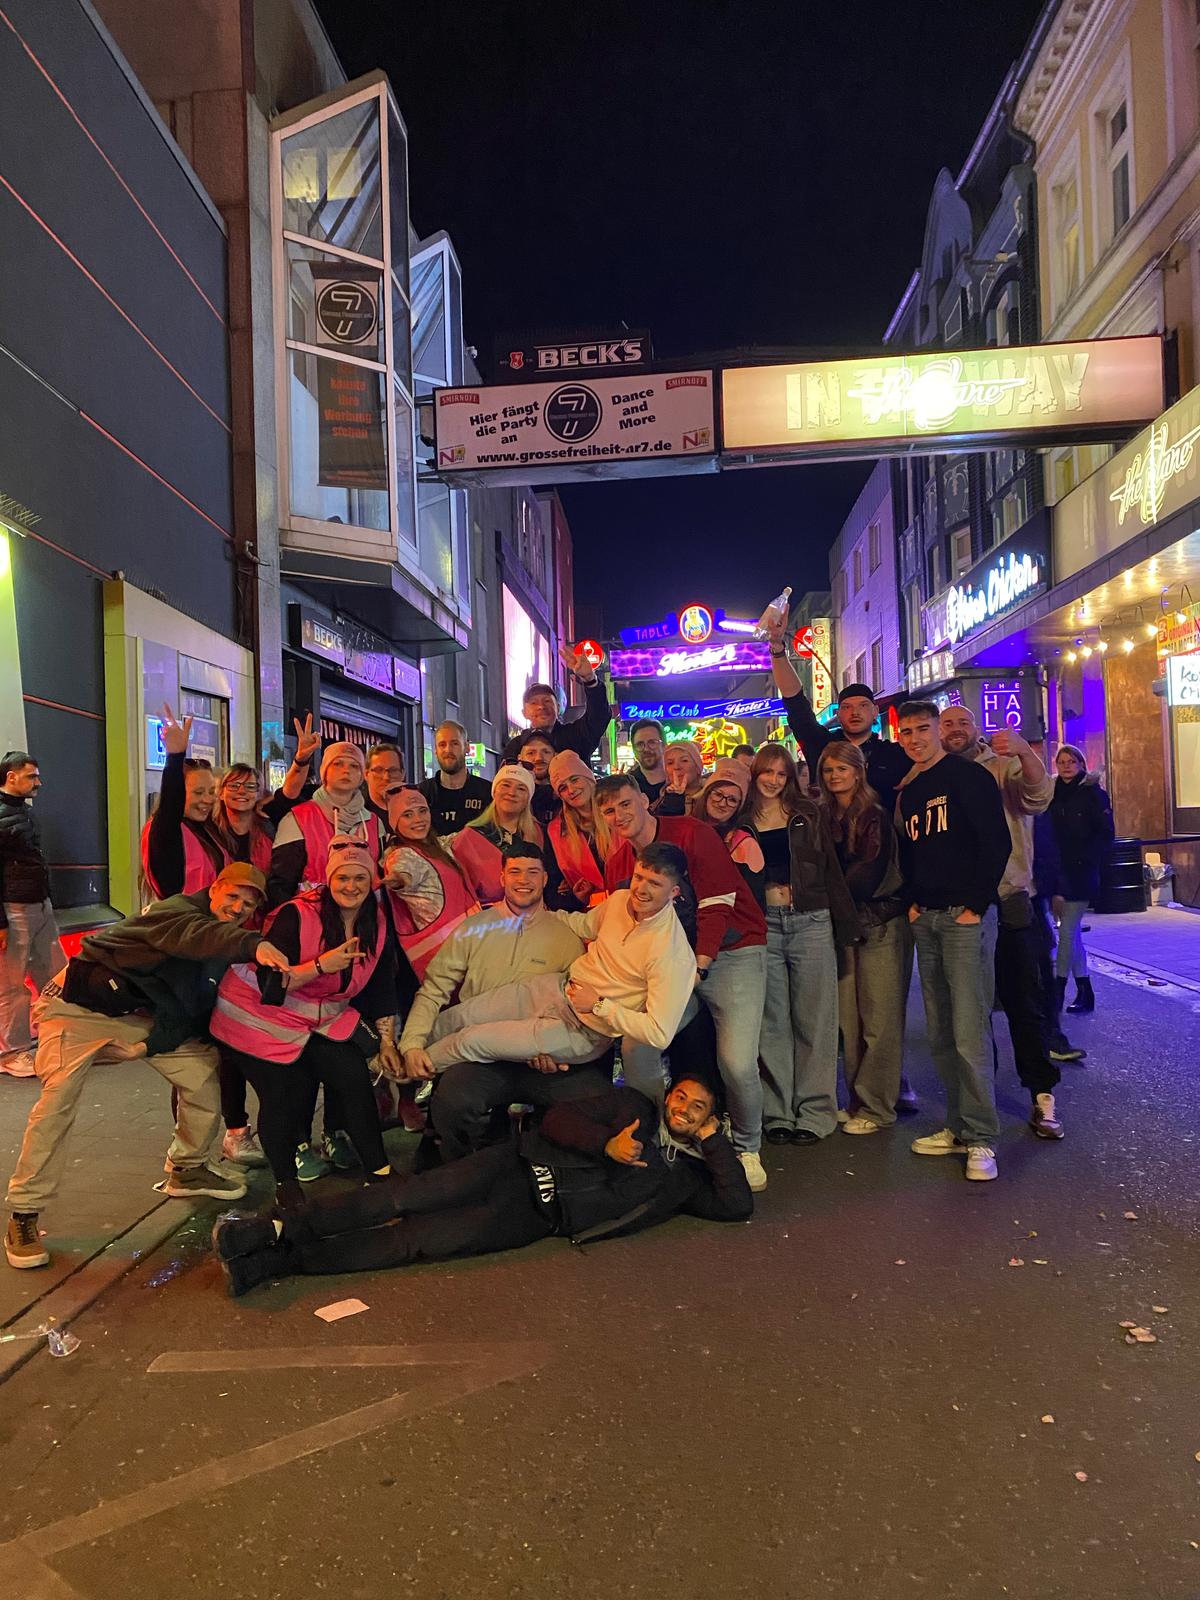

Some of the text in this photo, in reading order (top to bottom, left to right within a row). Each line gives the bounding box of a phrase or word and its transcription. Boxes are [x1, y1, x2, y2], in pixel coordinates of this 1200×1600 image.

[538, 340, 642, 369] BECK'S
[611, 389, 655, 406] Dance
[785, 371, 841, 430] IN
[965, 352, 1090, 417] WAY
[469, 412, 498, 426] Hier
[502, 401, 540, 418] fängt
[622, 401, 648, 416] and
[475, 425, 498, 437] die
[500, 416, 538, 432] Party
[619, 415, 657, 430] More
[501, 434, 518, 445] an
[635, 624, 670, 641] TABLE
[625, 703, 700, 718] Beach Club
